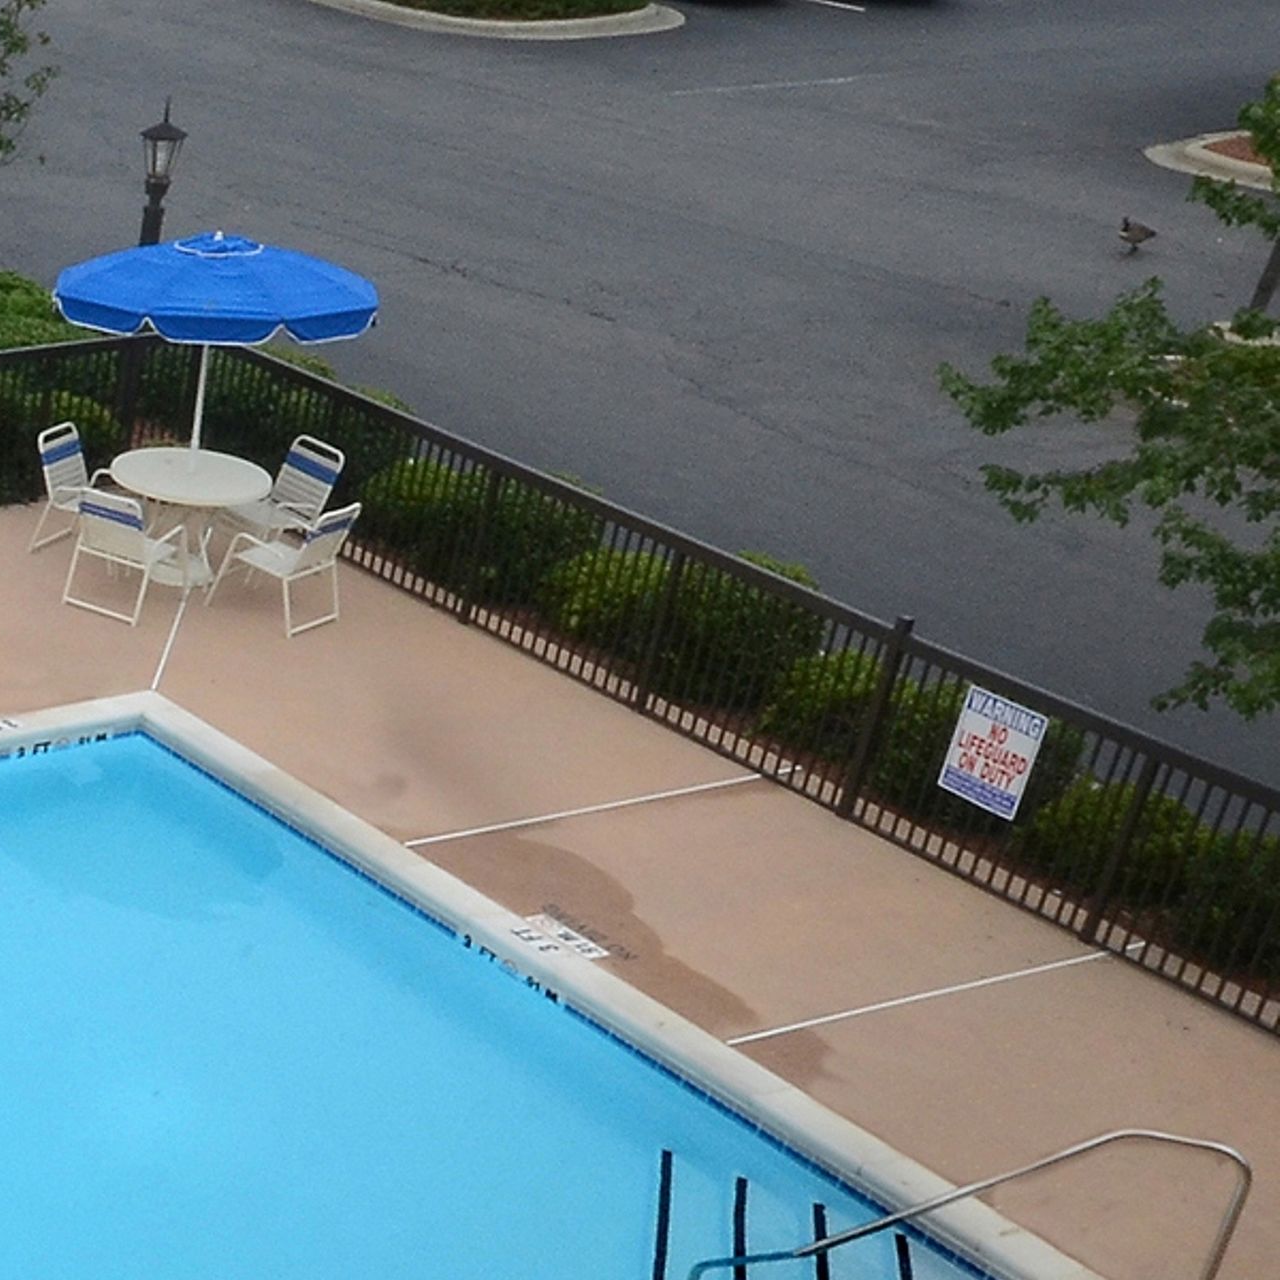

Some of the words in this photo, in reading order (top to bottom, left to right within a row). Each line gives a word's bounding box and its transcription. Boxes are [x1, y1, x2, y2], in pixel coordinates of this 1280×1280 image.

[968, 691, 1042, 737] WARNING
[33, 740, 51, 755] FT
[989, 724, 1009, 745] NO
[958, 729, 1028, 775] LIFEGUARD
[958, 753, 977, 771] ON
[980, 762, 1017, 790] DUTY
[479, 945, 498, 963] FT
